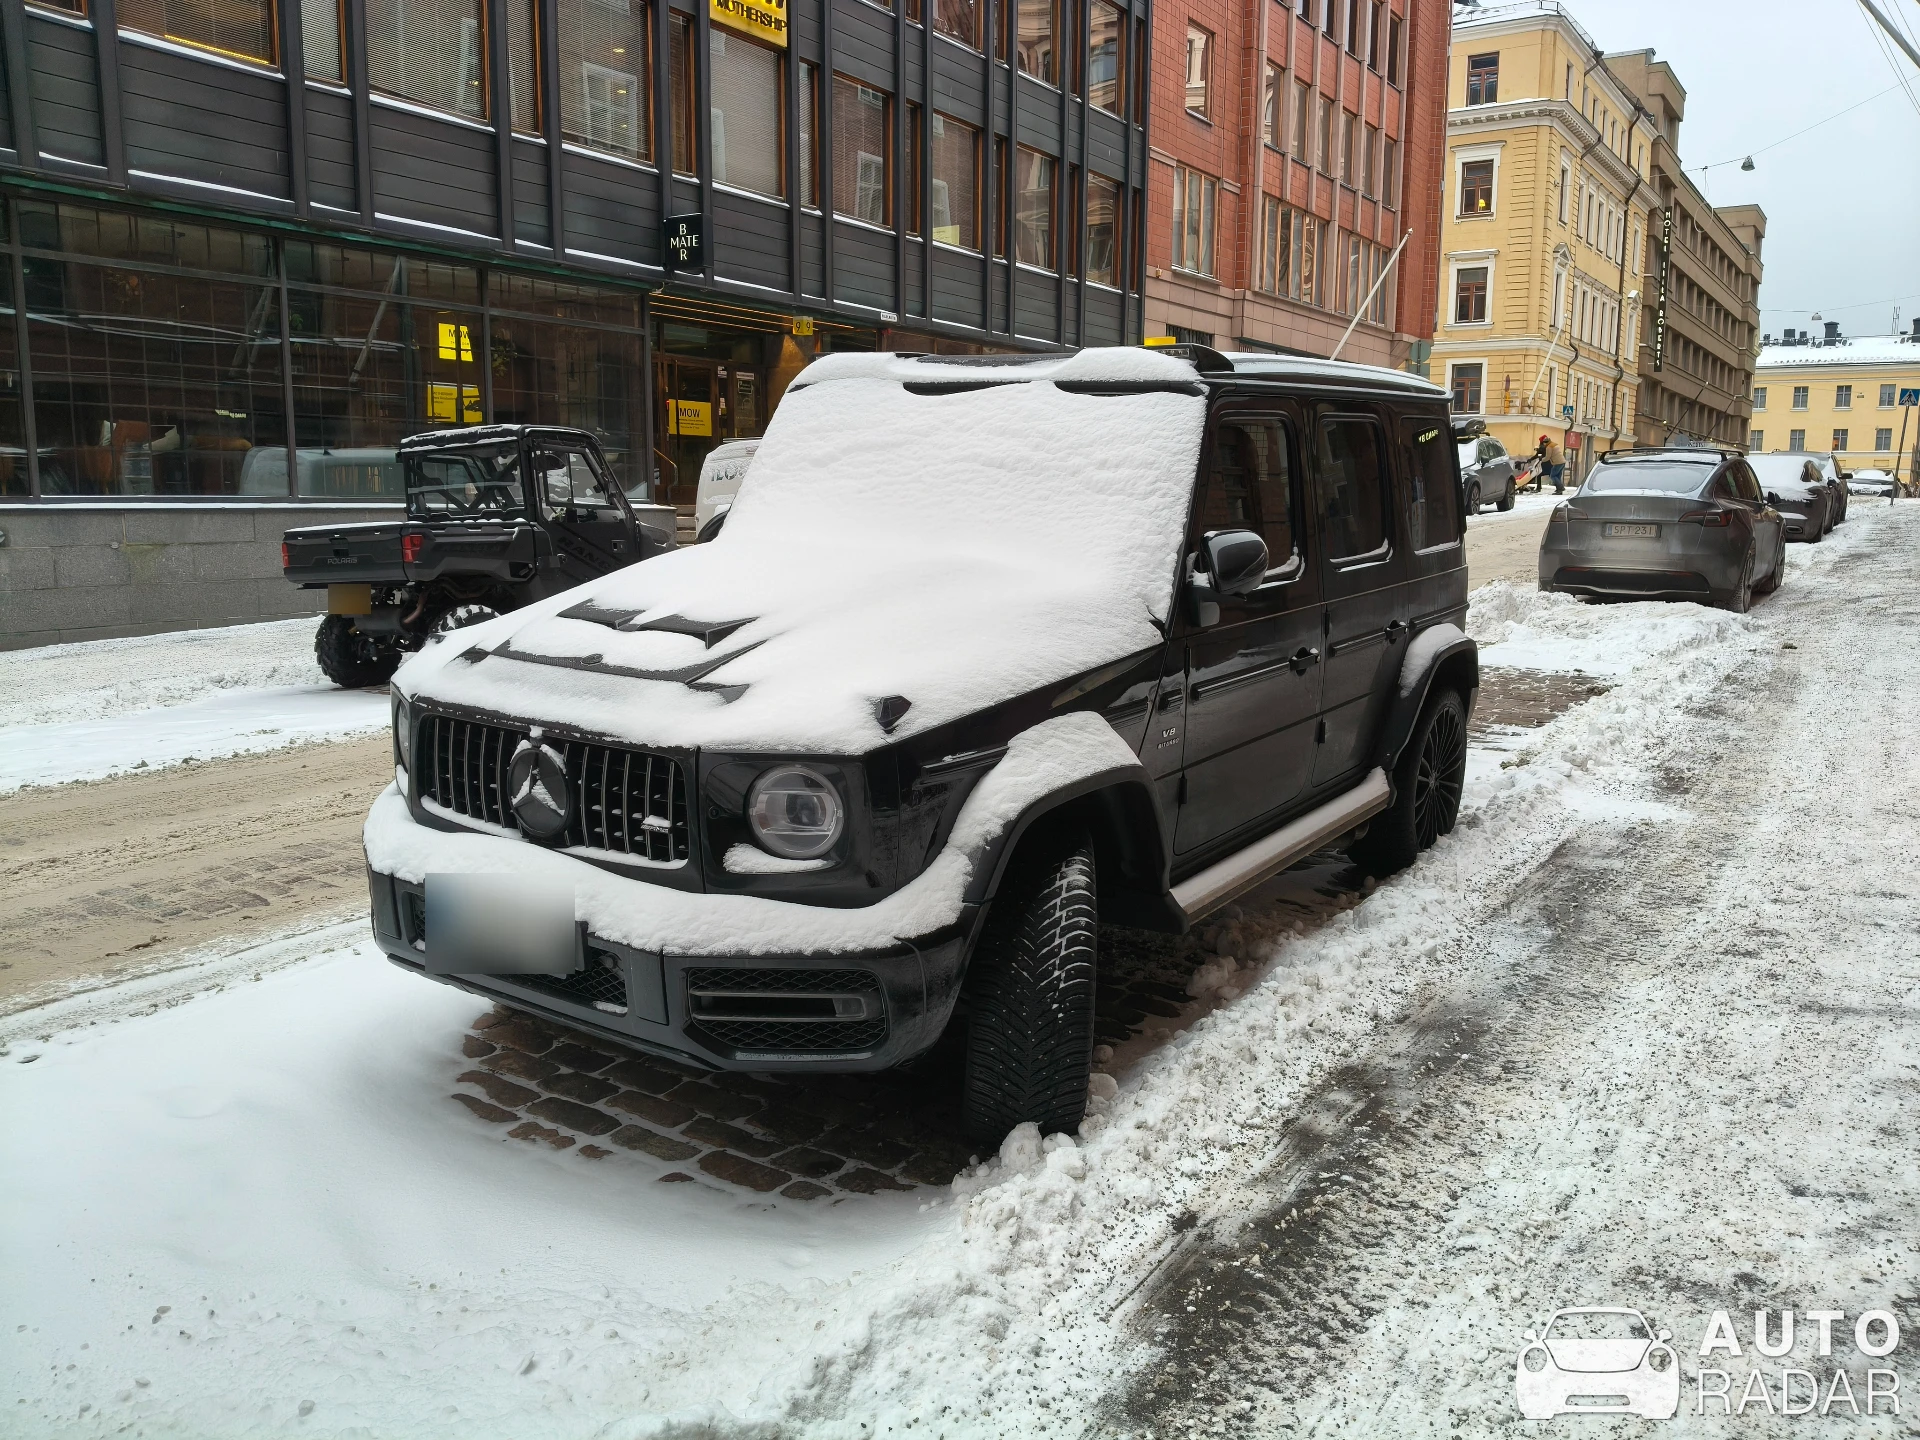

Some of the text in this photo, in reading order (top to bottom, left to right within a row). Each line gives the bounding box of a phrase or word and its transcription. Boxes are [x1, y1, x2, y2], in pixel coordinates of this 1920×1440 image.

[716, 0, 787, 31] MOTHERSHIP
[670, 234, 699, 249] MATE
[1663, 211, 1671, 252] HOTEL
[679, 407, 700, 418] MOW
